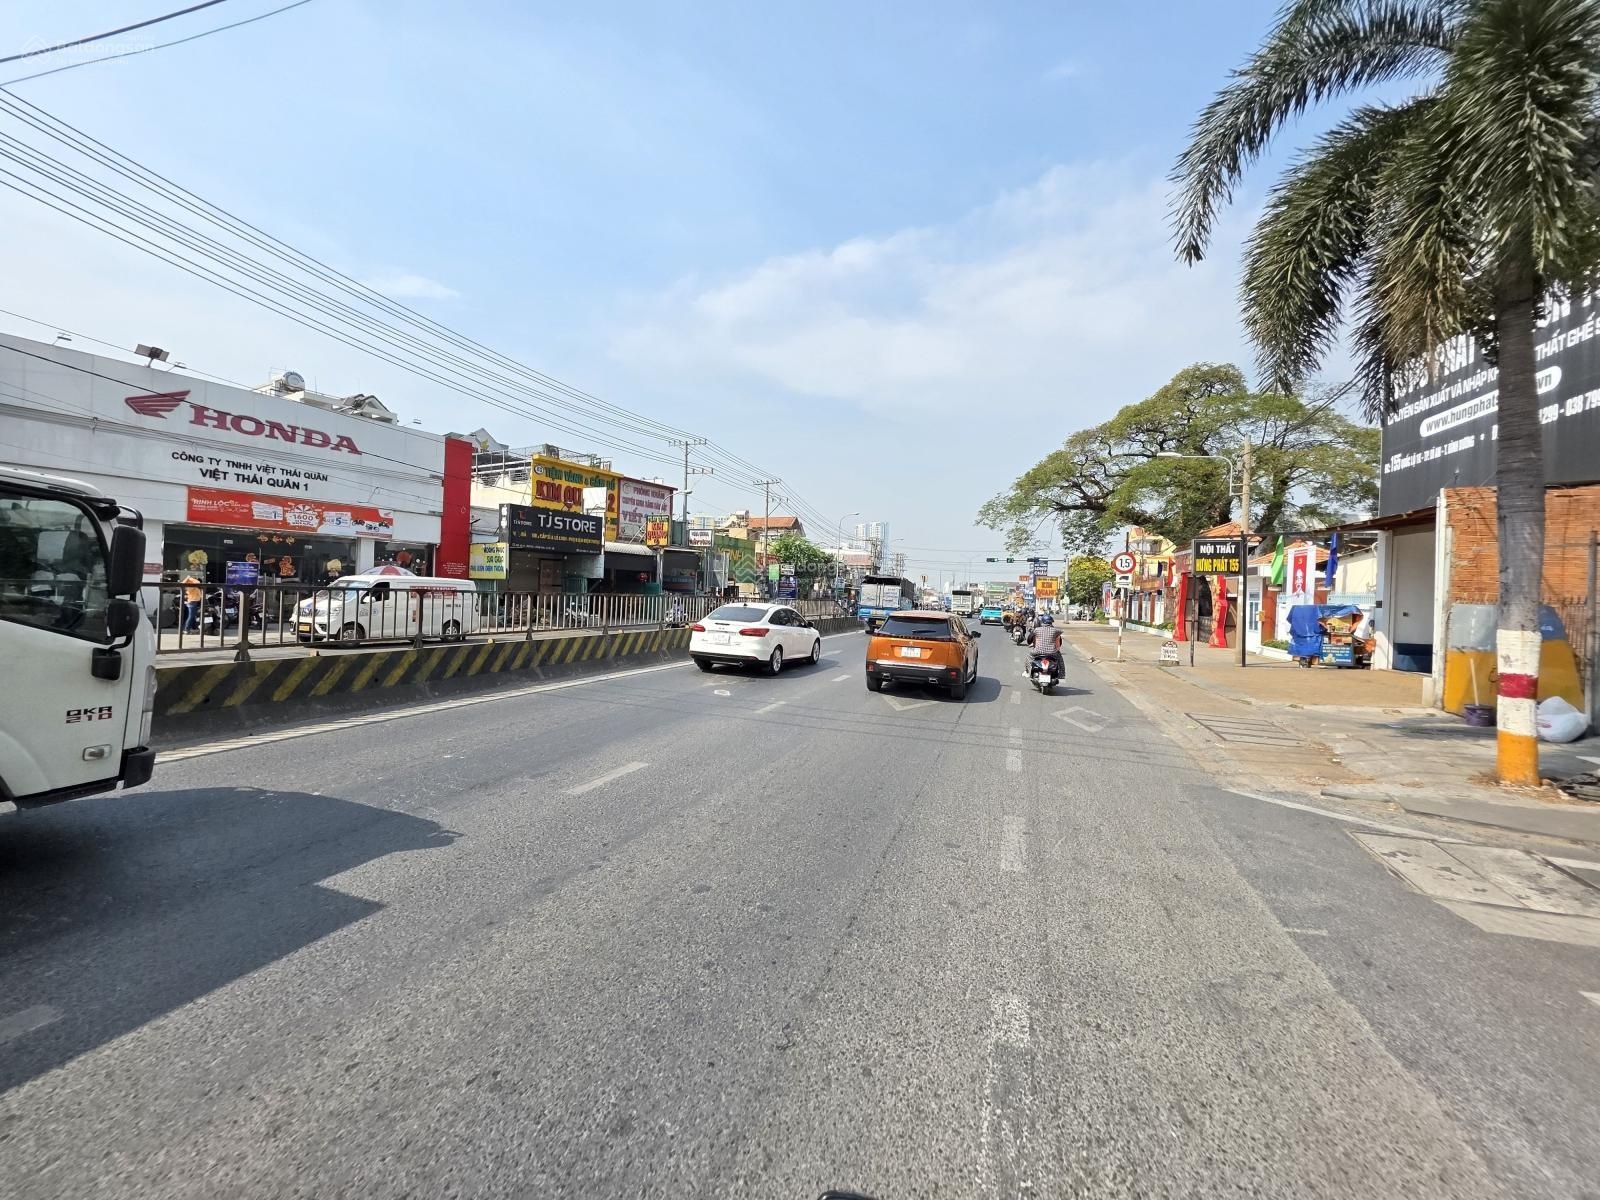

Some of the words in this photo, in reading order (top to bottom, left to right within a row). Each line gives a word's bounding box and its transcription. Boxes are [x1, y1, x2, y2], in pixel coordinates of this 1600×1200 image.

[1426, 393, 1498, 433] www.hungphat
[189, 404, 363, 455] HONDA
[171, 450, 204, 464] CÔNG
[207, 457, 221, 466] TY
[227, 460, 253, 471] TNHH
[280, 467, 301, 478] THÁI
[303, 470, 329, 482] QUÂN
[199, 467, 228, 482] VIỆT
[235, 472, 263, 485] THÁI
[267, 477, 300, 490] QUÂN
[303, 482, 309, 491] 1
[564, 470, 583, 484] VÀNG
[536, 480, 562, 503] KIM
[608, 493, 616, 512] 2
[1199, 543, 1214, 555] NỘI
[1215, 541, 1236, 554] THẤT
[1212, 555, 1229, 572] PHÁT
[1229, 558, 1240, 572] 155
[65, 712, 113, 724] 210
[66, 705, 113, 717] QKR
